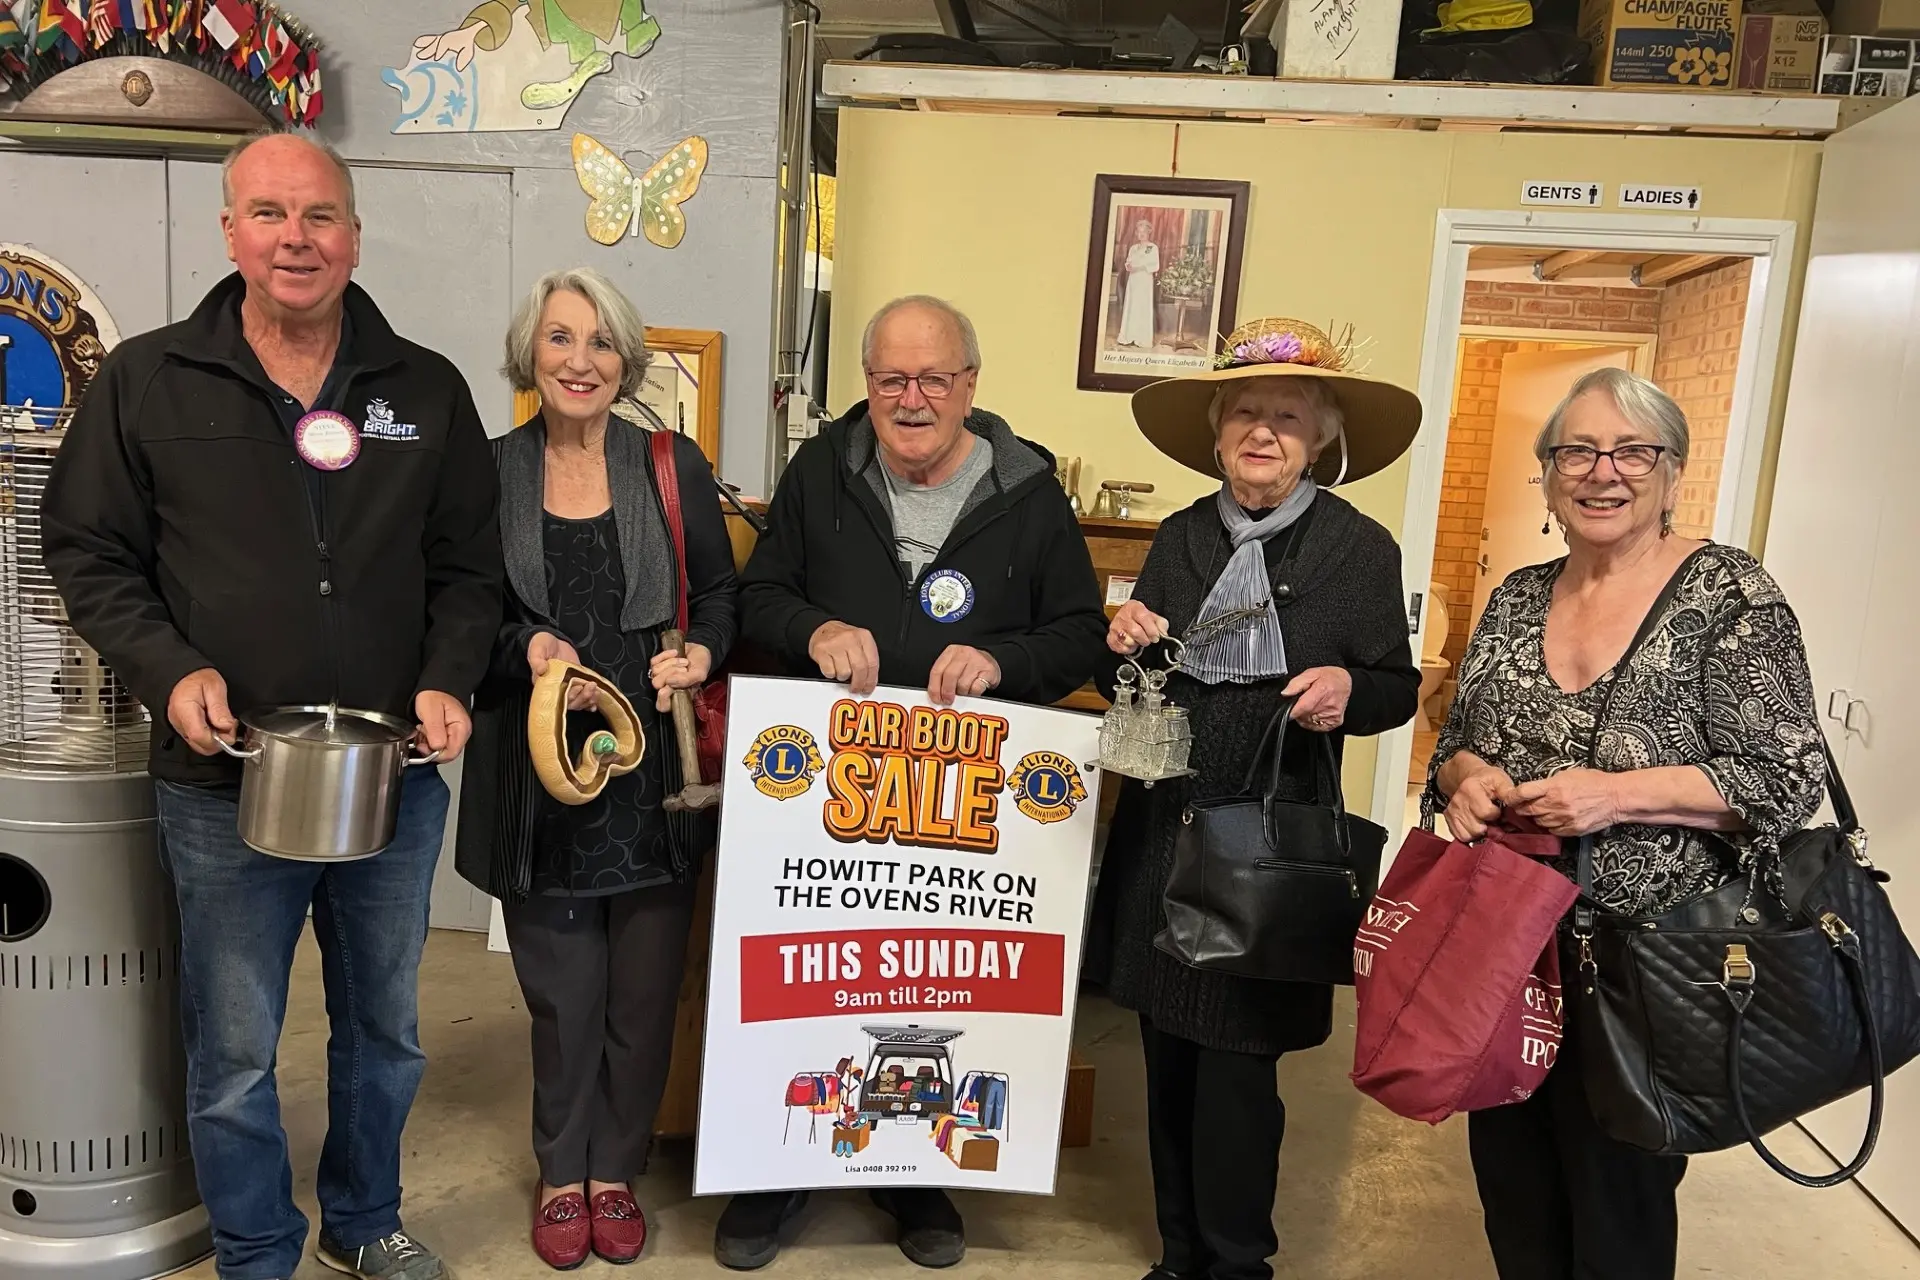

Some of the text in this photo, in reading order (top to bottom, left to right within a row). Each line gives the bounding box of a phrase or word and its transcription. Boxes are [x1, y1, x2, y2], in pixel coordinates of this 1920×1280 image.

[1625, 0, 1729, 17] CHAMPAGNE
[1676, 15, 1732, 31] FLUTES
[1615, 45, 1673, 58] 144ml 250
[1527, 185, 1582, 200] GENTS
[1623, 189, 1683, 205] LADIES
[1118, 355, 1142, 363] Majesty
[1145, 356, 1165, 365] Queen
[1167, 358, 1197, 367] Elizabeth
[363, 420, 417, 436] BRIGHT
[930, 569, 953, 581] CLUBS
[763, 728, 810, 745] LIONS
[831, 700, 1006, 763] CAR BOOT
[775, 748, 796, 775] L
[1026, 753, 1073, 775] LIONS
[760, 780, 806, 795] INTERNATIONAL
[1037, 773, 1058, 800] L
[826, 752, 1002, 848] SALE
[1022, 802, 1068, 819] INTERNATIONAL
[783, 858, 1037, 898] HOWITT PARK ON
[774, 886, 1034, 924] THE OVENS RIVER
[779, 939, 1025, 984] THIS SUNDAY
[834, 986, 972, 1008] 9am till 2pm
[845, 1165, 917, 1173] Lisa 0408 392 919
